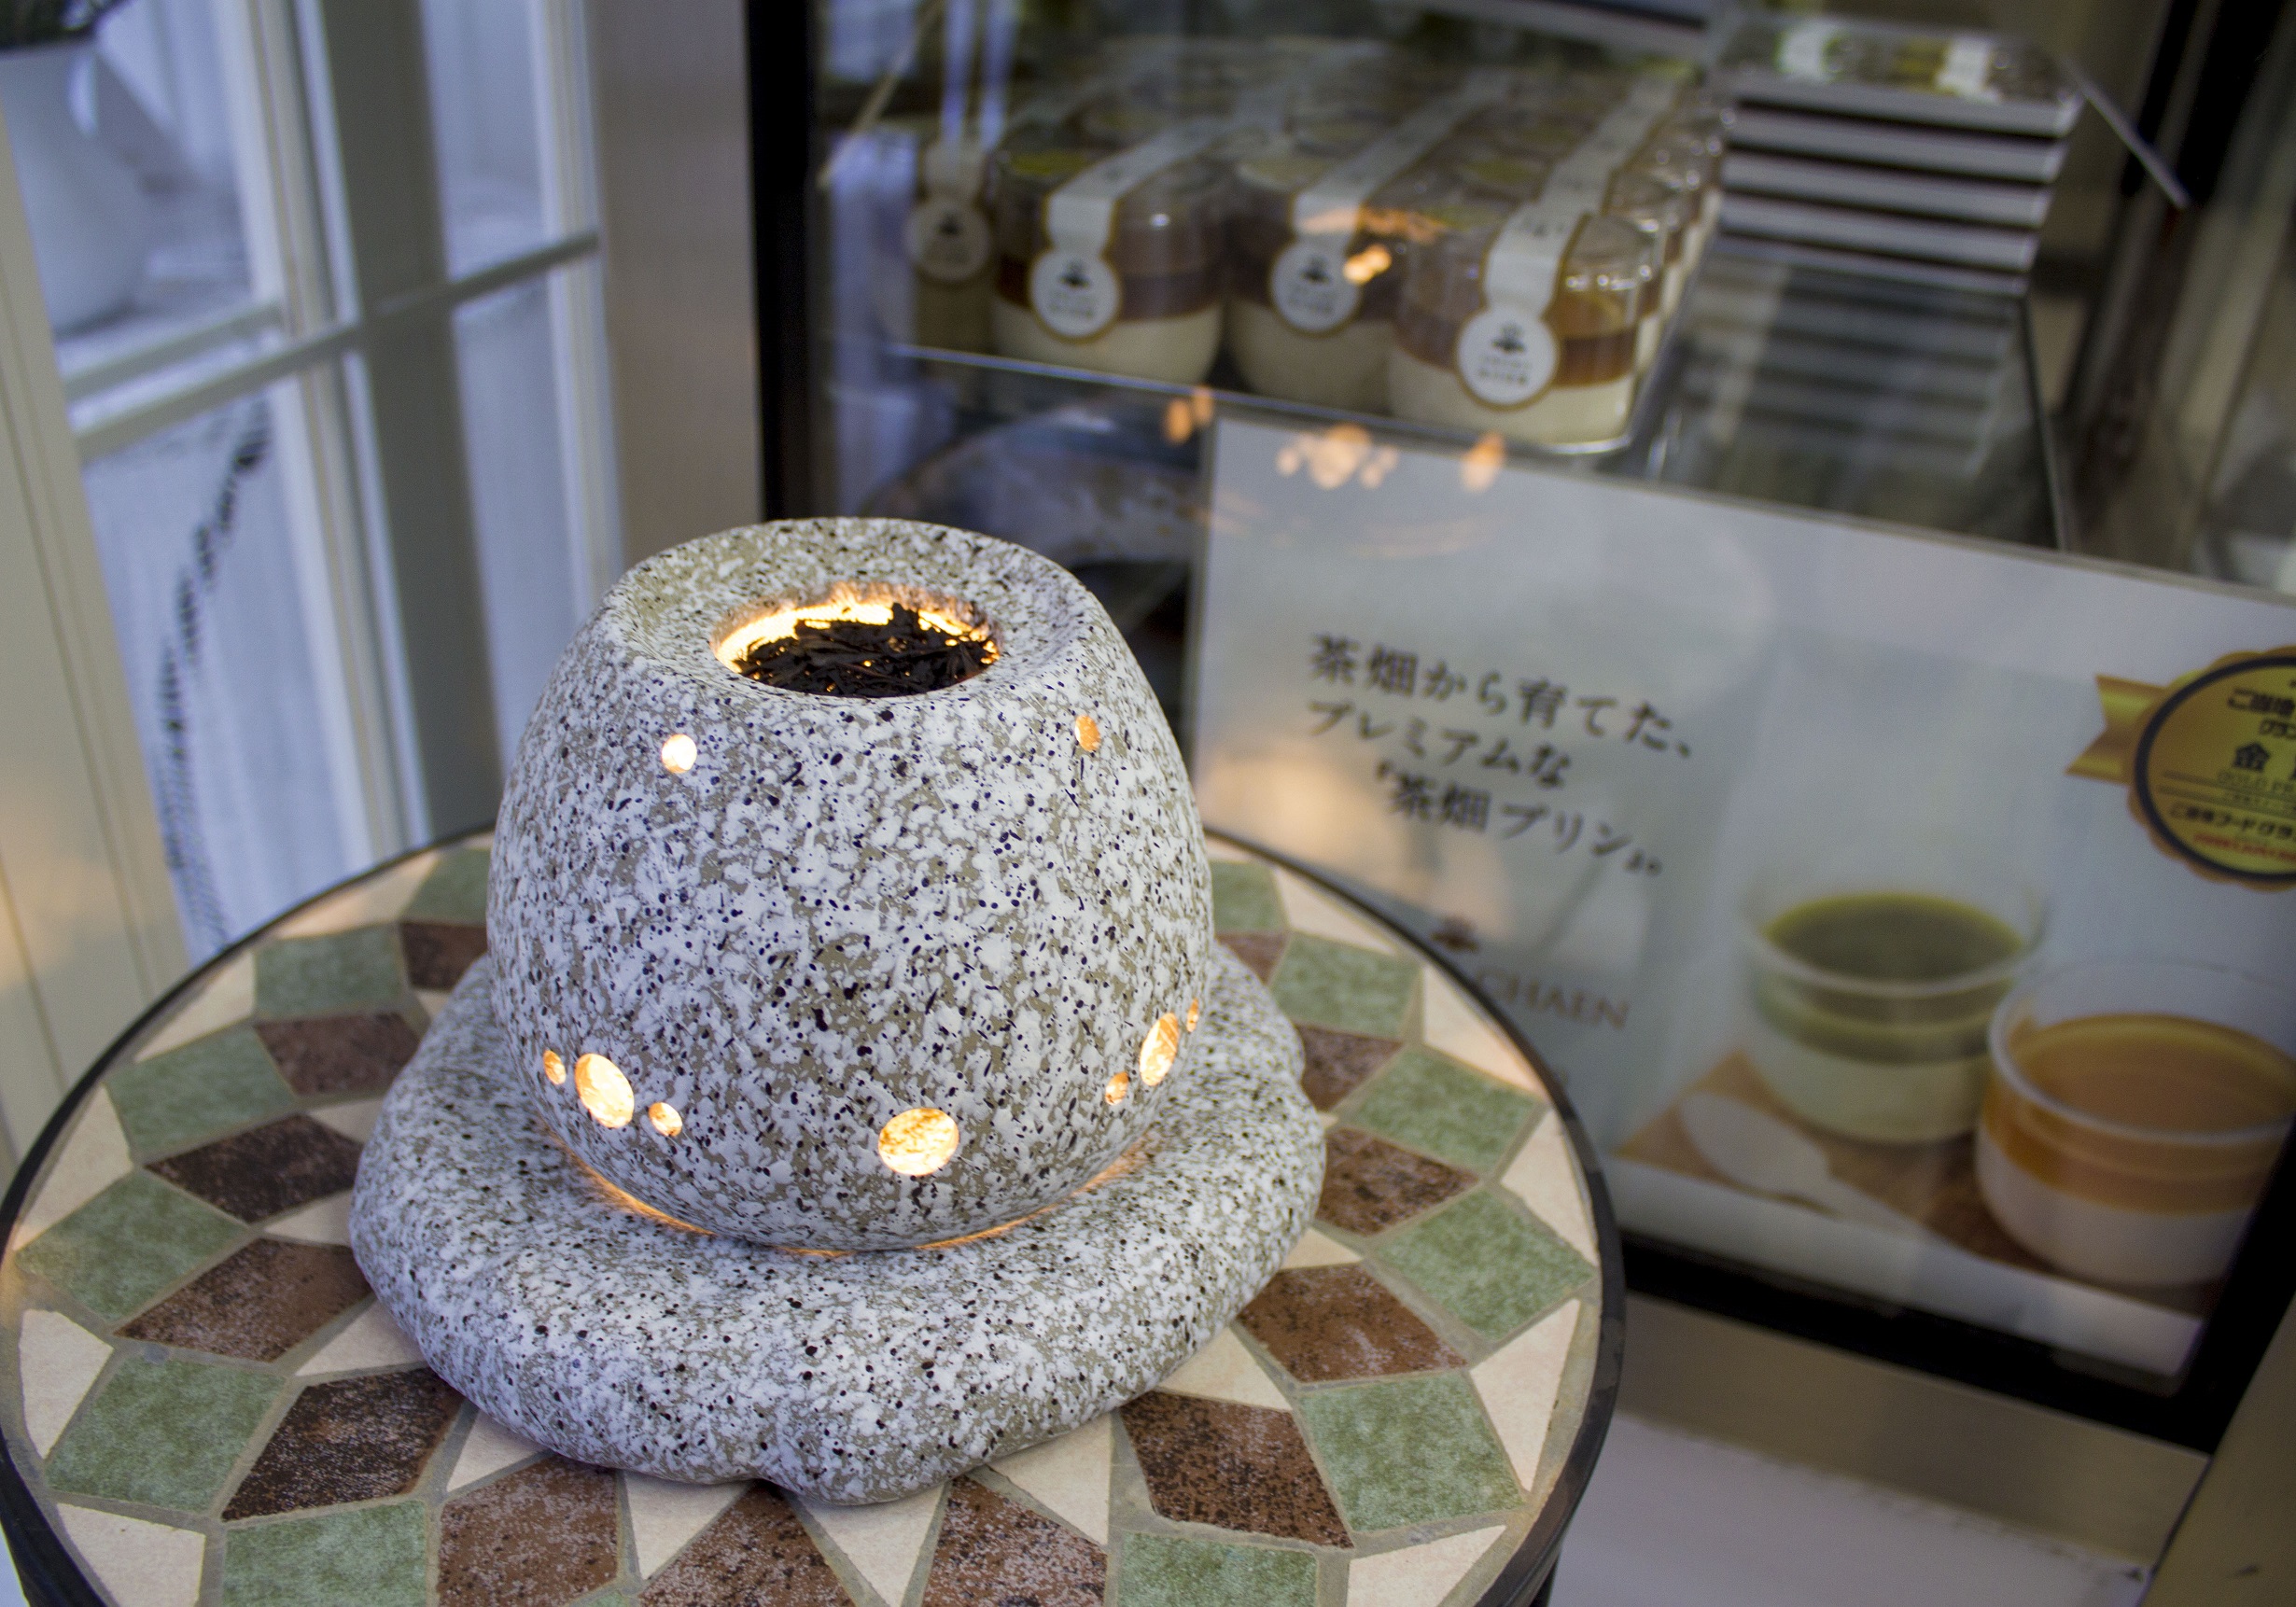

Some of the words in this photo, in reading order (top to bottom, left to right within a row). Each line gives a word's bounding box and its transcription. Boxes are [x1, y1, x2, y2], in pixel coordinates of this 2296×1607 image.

[1308, 700, 1572, 789] プレミアムな
[1310, 633, 1691, 759] 茶畑から育てた、
